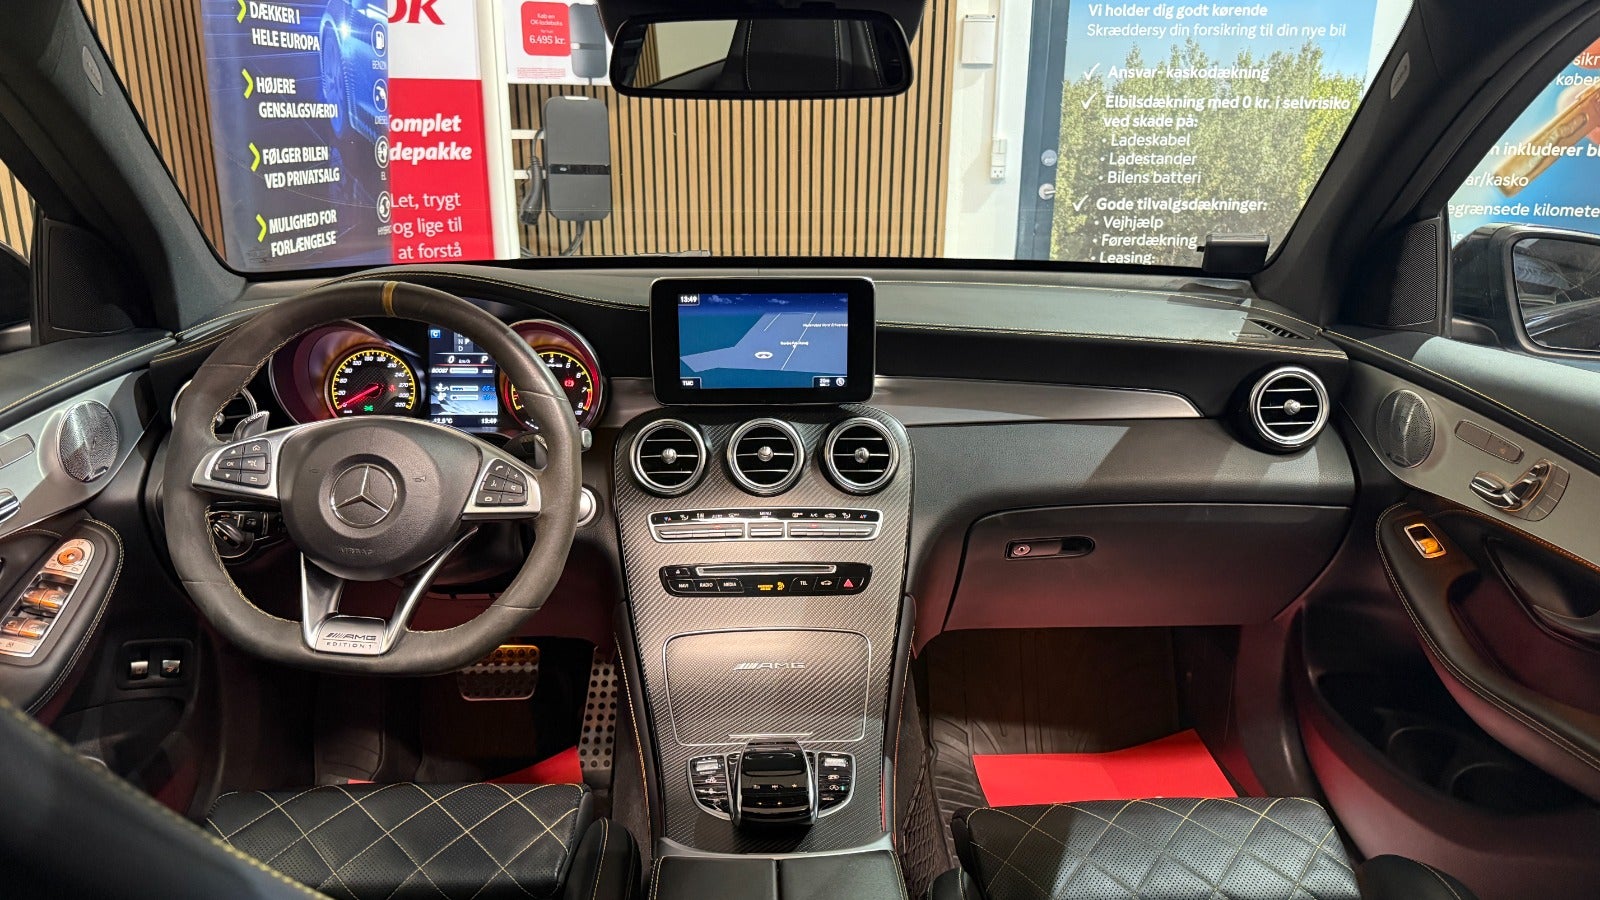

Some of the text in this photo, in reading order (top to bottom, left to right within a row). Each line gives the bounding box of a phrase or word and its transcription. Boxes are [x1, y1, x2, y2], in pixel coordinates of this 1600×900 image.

[249, 1, 301, 25] DÆKKER I
[1088, 4, 1268, 20] Vi holder dig godt kørende
[251, 28, 320, 51] HELE EUROPA
[529, 34, 566, 45] 6.495 kr.
[1087, 23, 1347, 39] Skræddersy din forsikring til din nye bil
[1107, 65, 1270, 82] Ansvar- kaskodækning
[256, 77, 296, 94] HØJERE
[259, 102, 339, 118] GENSALGSVÆRDI
[1105, 94, 1351, 111] Elbilsdækning med 0 kr. i selvrisiko
[389, 113, 462, 137] omplet
[1103, 113, 1199, 131] ved skade på:
[1111, 133, 1191, 147] Ladeskabel
[262, 146, 329, 165] FØLGER BILEN
[1503, 142, 1584, 157] inkluderer
[1109, 152, 1198, 165] Ladestander
[264, 167, 340, 189] VED PRIVATSALG
[1107, 171, 1202, 184] Bilens batteri
[391, 192, 462, 211] Let, trygt
[1096, 197, 1268, 214] Gode tilvalgsdækninger:
[269, 209, 337, 234] MULIGHED FOR
[392, 216, 463, 238] og lige til
[1103, 216, 1164, 231] Vejhjælp
[270, 230, 337, 257] FORLÆNGELSE
[1101, 233, 1198, 250] Førerdækning
[398, 241, 463, 260] at forstå
[1099, 252, 1155, 265] Leasing:
[680, 295, 697, 303] 13:49
[447, 355, 455, 364] 0
[480, 355, 489, 364] P
[326, 641, 365, 649] EDITION
